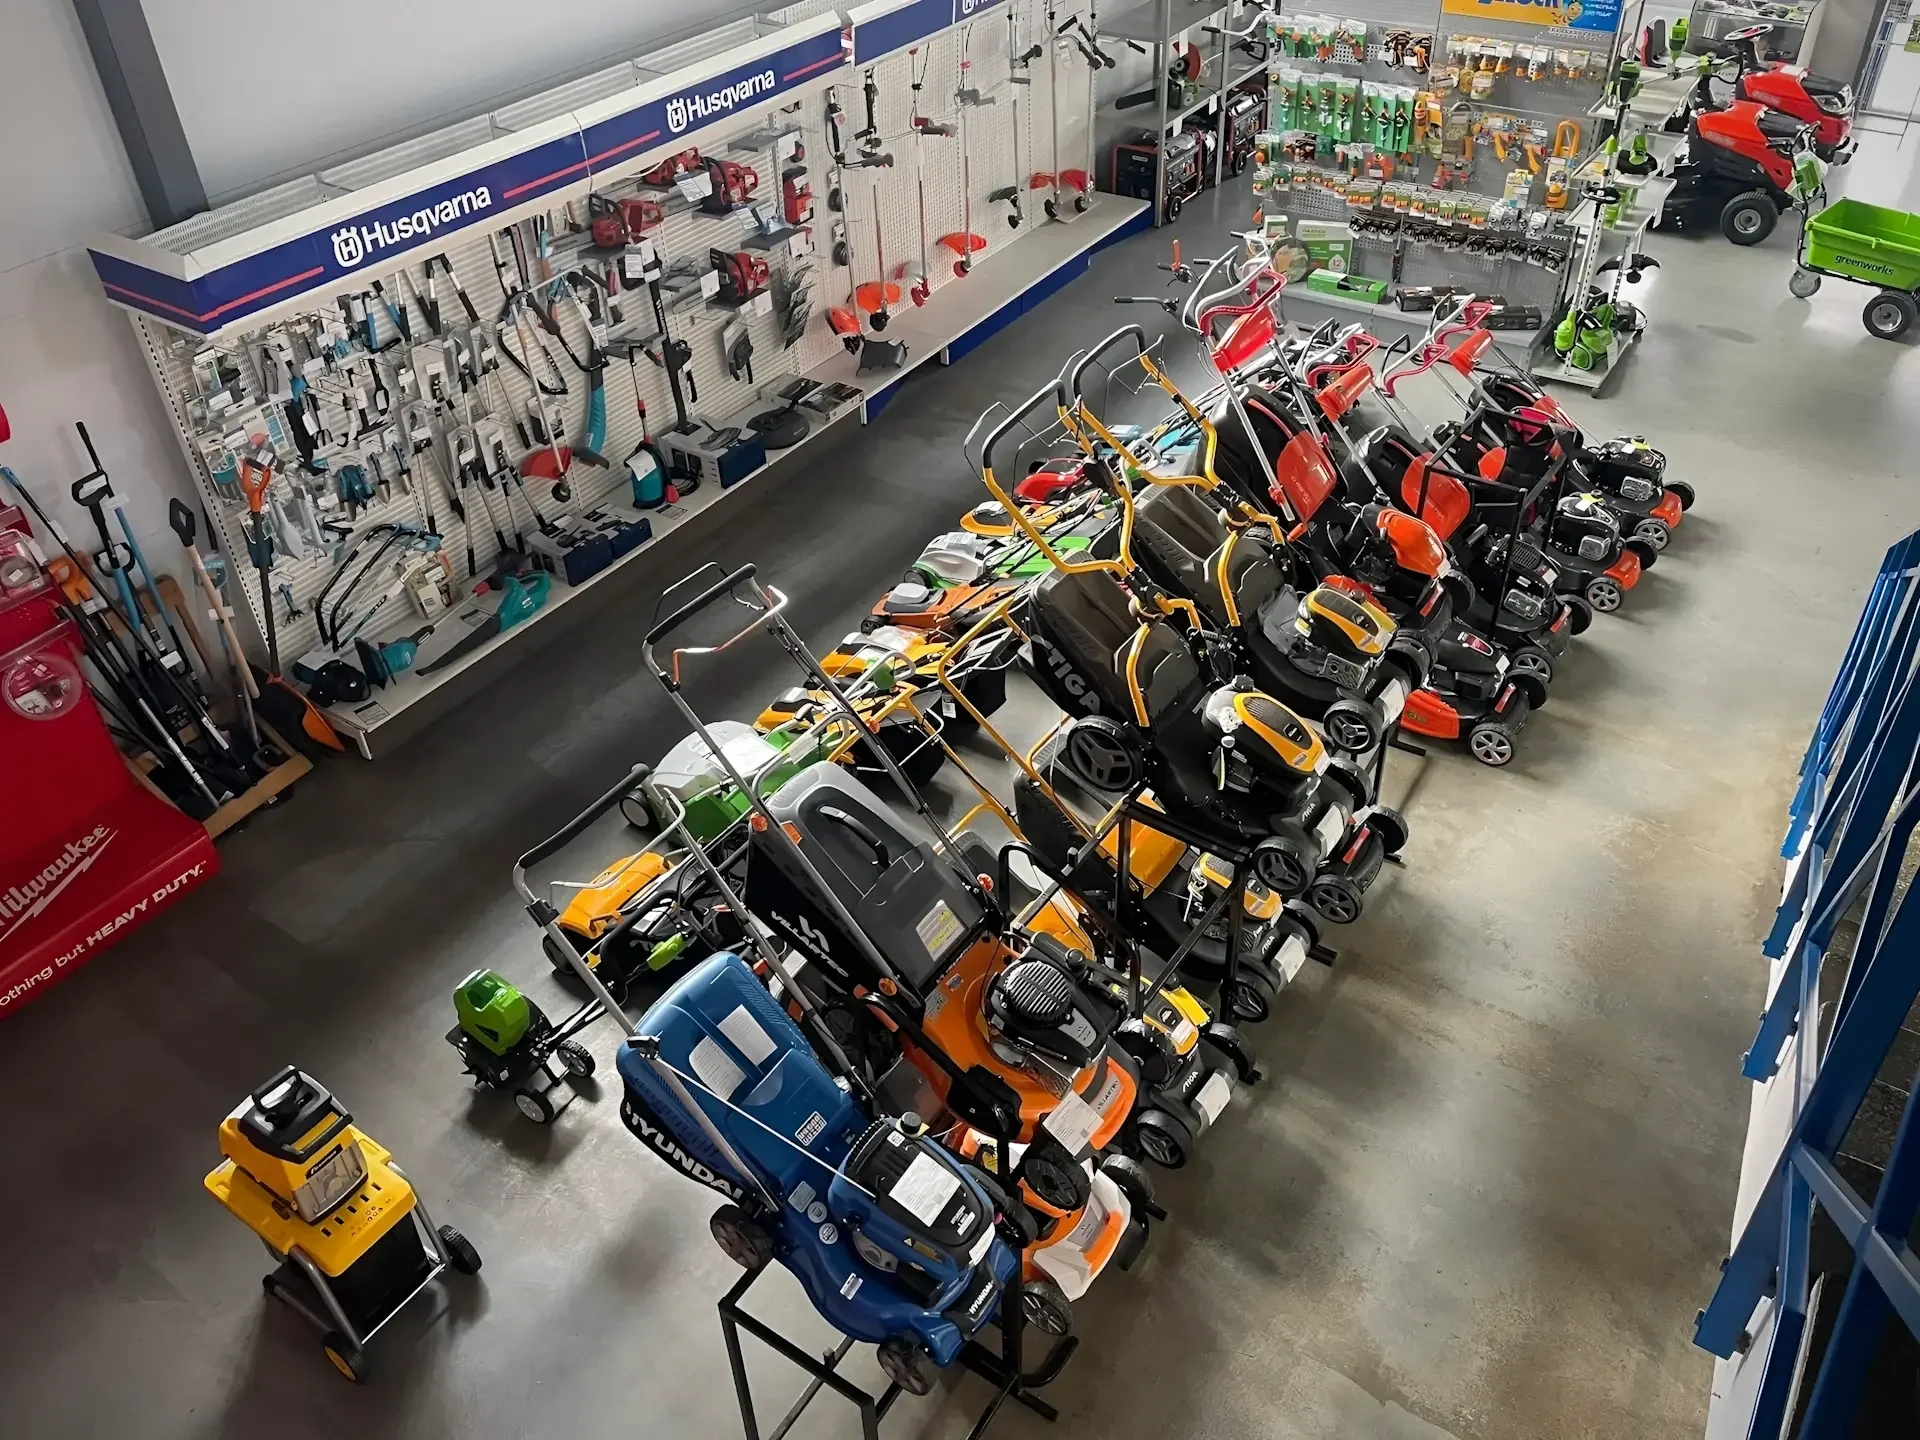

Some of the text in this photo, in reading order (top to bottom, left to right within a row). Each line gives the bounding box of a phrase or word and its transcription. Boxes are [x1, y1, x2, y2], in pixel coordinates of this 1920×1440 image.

[686, 70, 775, 121] Husqvarna
[361, 187, 492, 253] Husqvarna
[1835, 255, 1894, 275] greenworks
[0, 966, 53, 1006] othing
[55, 943, 86, 968] but
[86, 898, 149, 946] HEAVY
[968, 1280, 995, 1315] HYUNDAI
